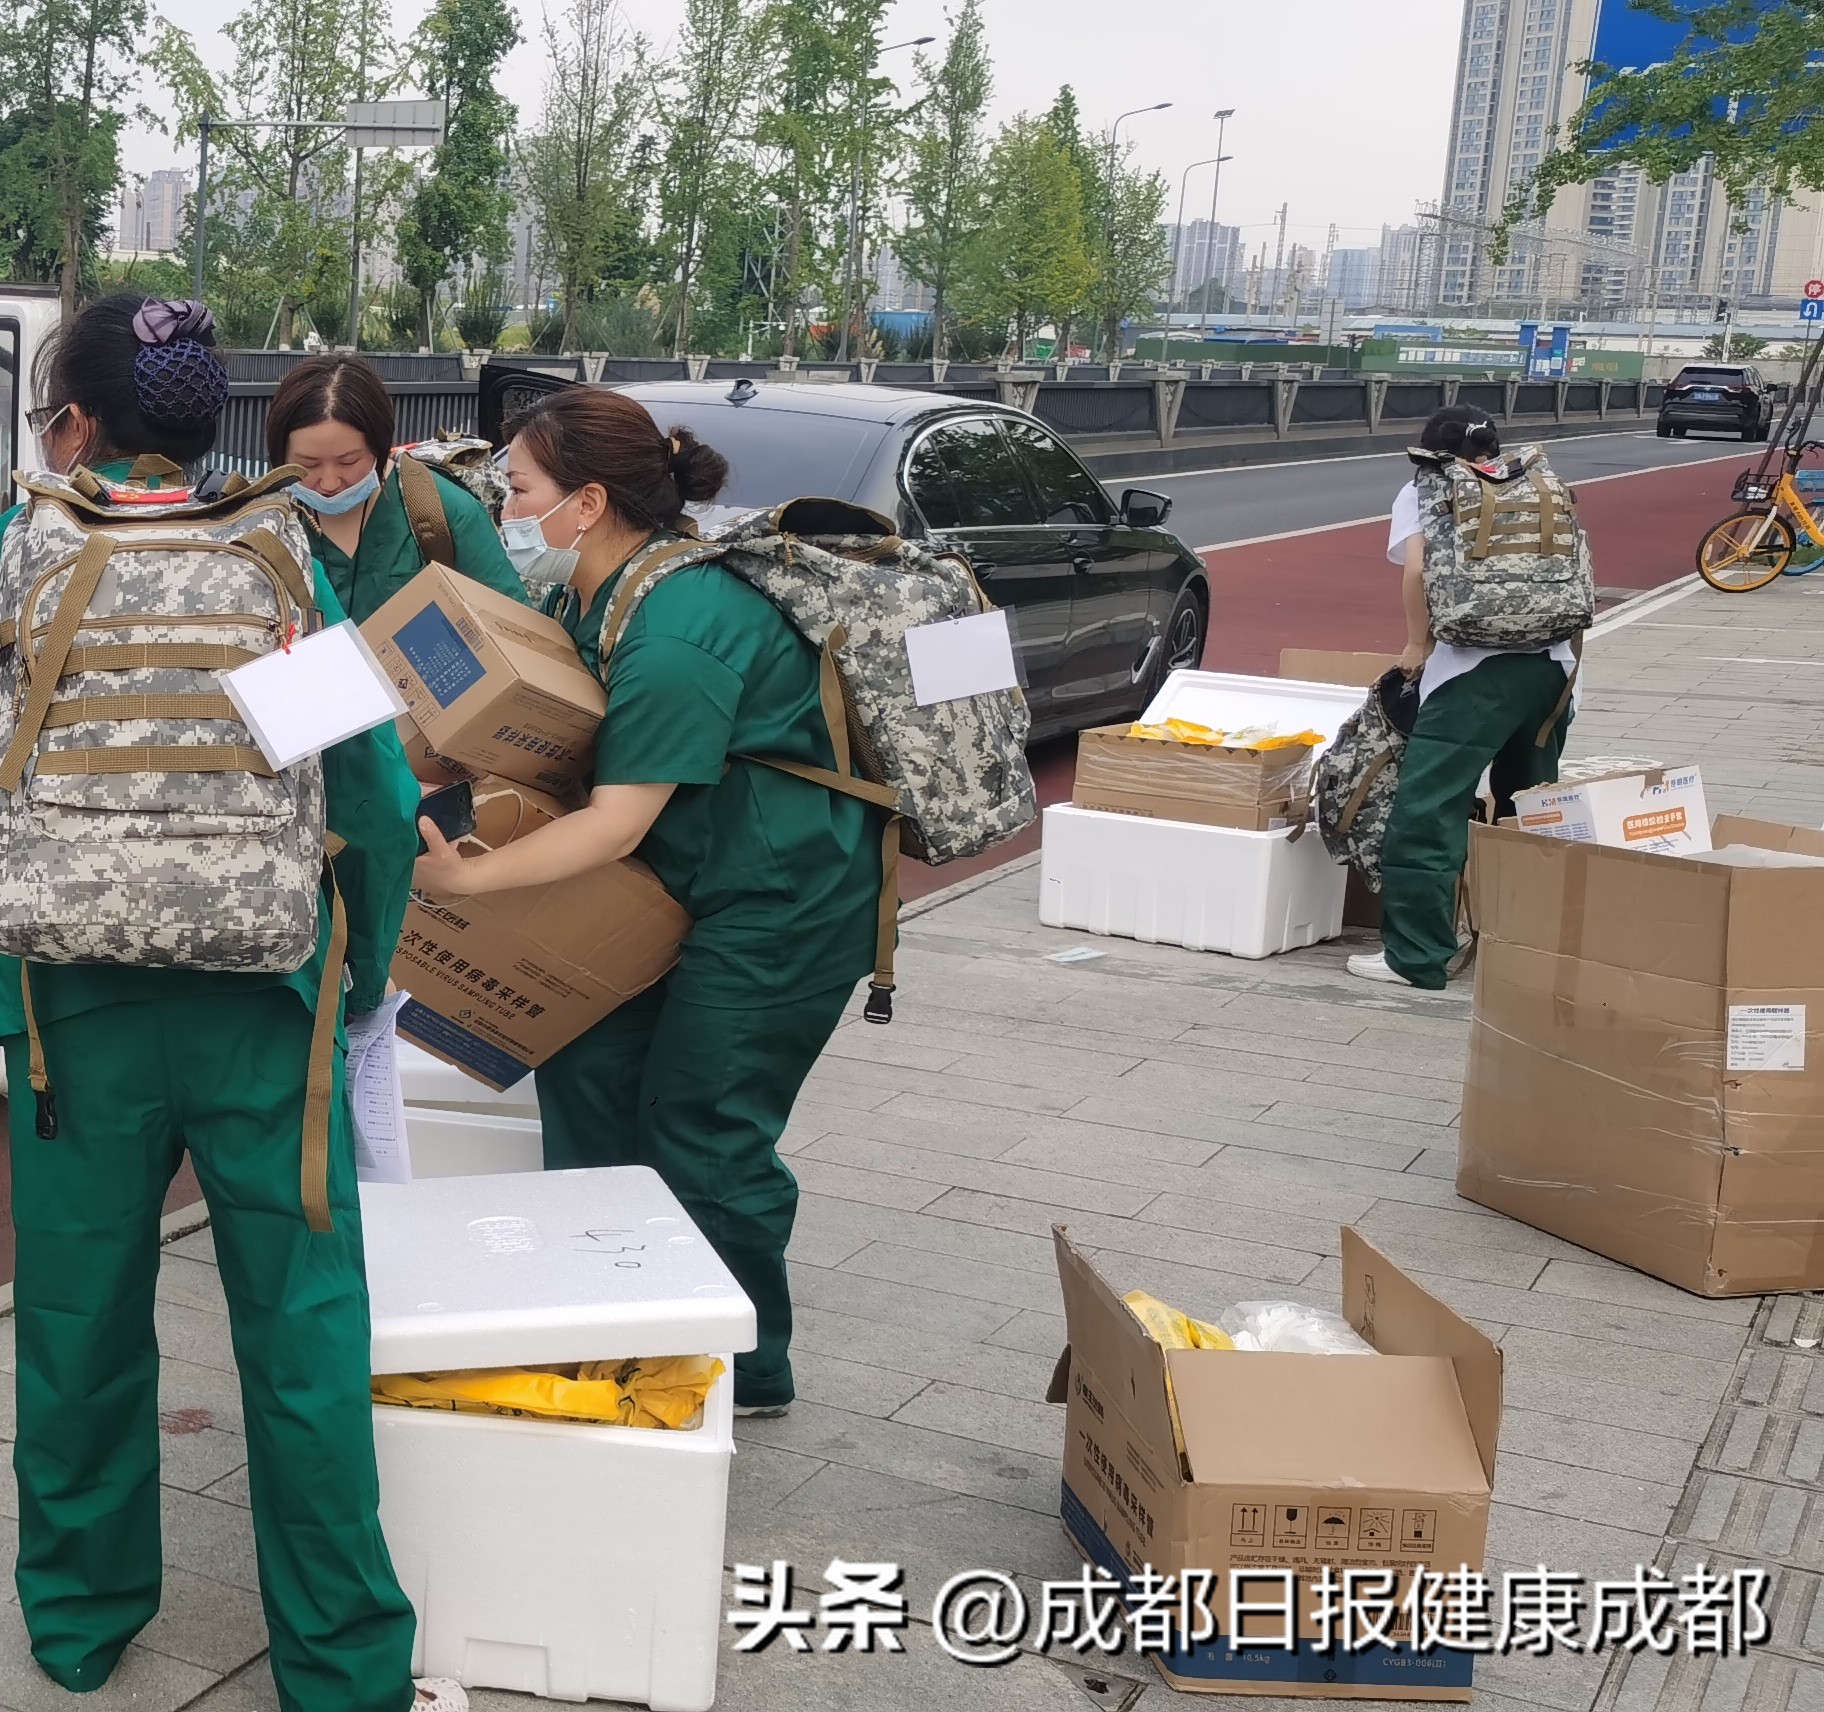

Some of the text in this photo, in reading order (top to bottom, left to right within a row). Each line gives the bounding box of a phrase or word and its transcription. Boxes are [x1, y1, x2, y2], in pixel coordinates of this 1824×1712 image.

[399, 929, 546, 1019] 次性使用病毒采样管
